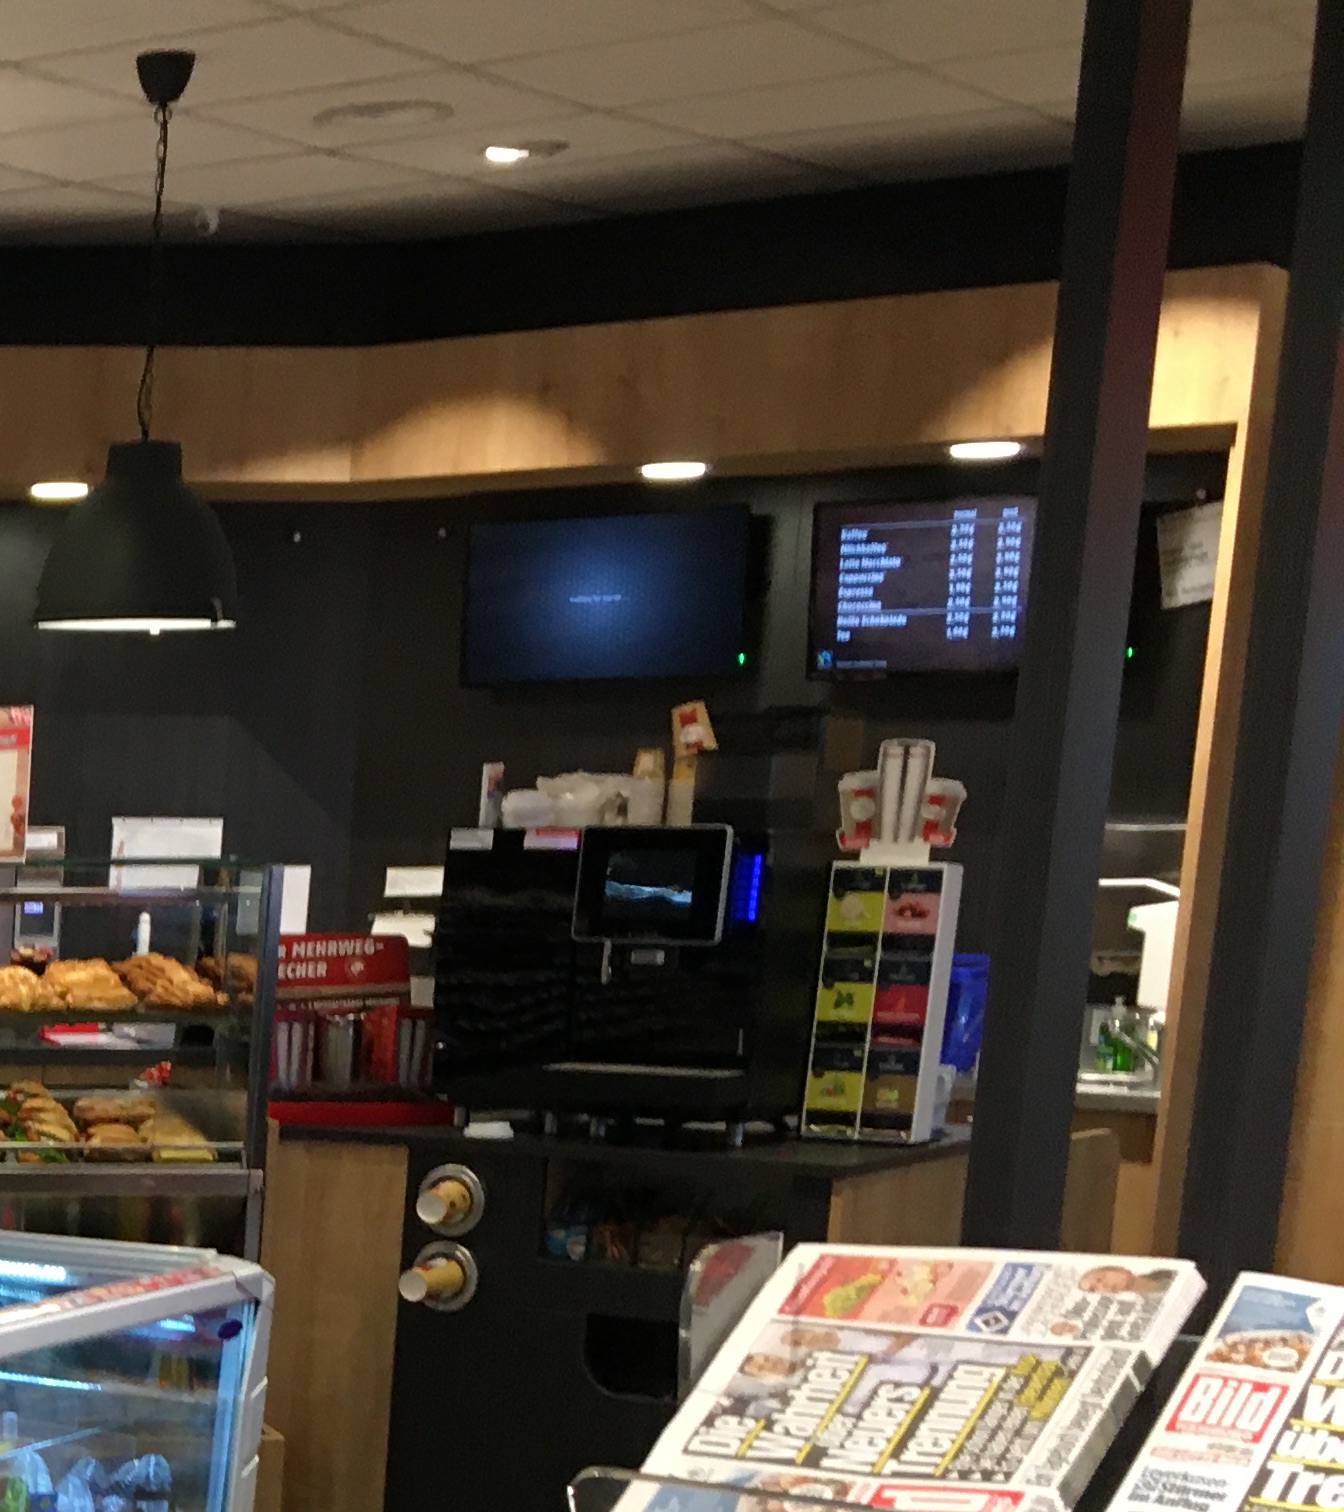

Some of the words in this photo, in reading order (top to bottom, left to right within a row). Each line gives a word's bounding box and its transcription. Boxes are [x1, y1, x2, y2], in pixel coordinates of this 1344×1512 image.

[277, 961, 328, 980] ECHER
[688, 1414, 757, 1451] Die
[750, 1350, 865, 1459] Wahrheit
[819, 1383, 924, 1469] Neuers
[883, 1361, 1005, 1479] Trennung
[1178, 1375, 1283, 1437] Bild
